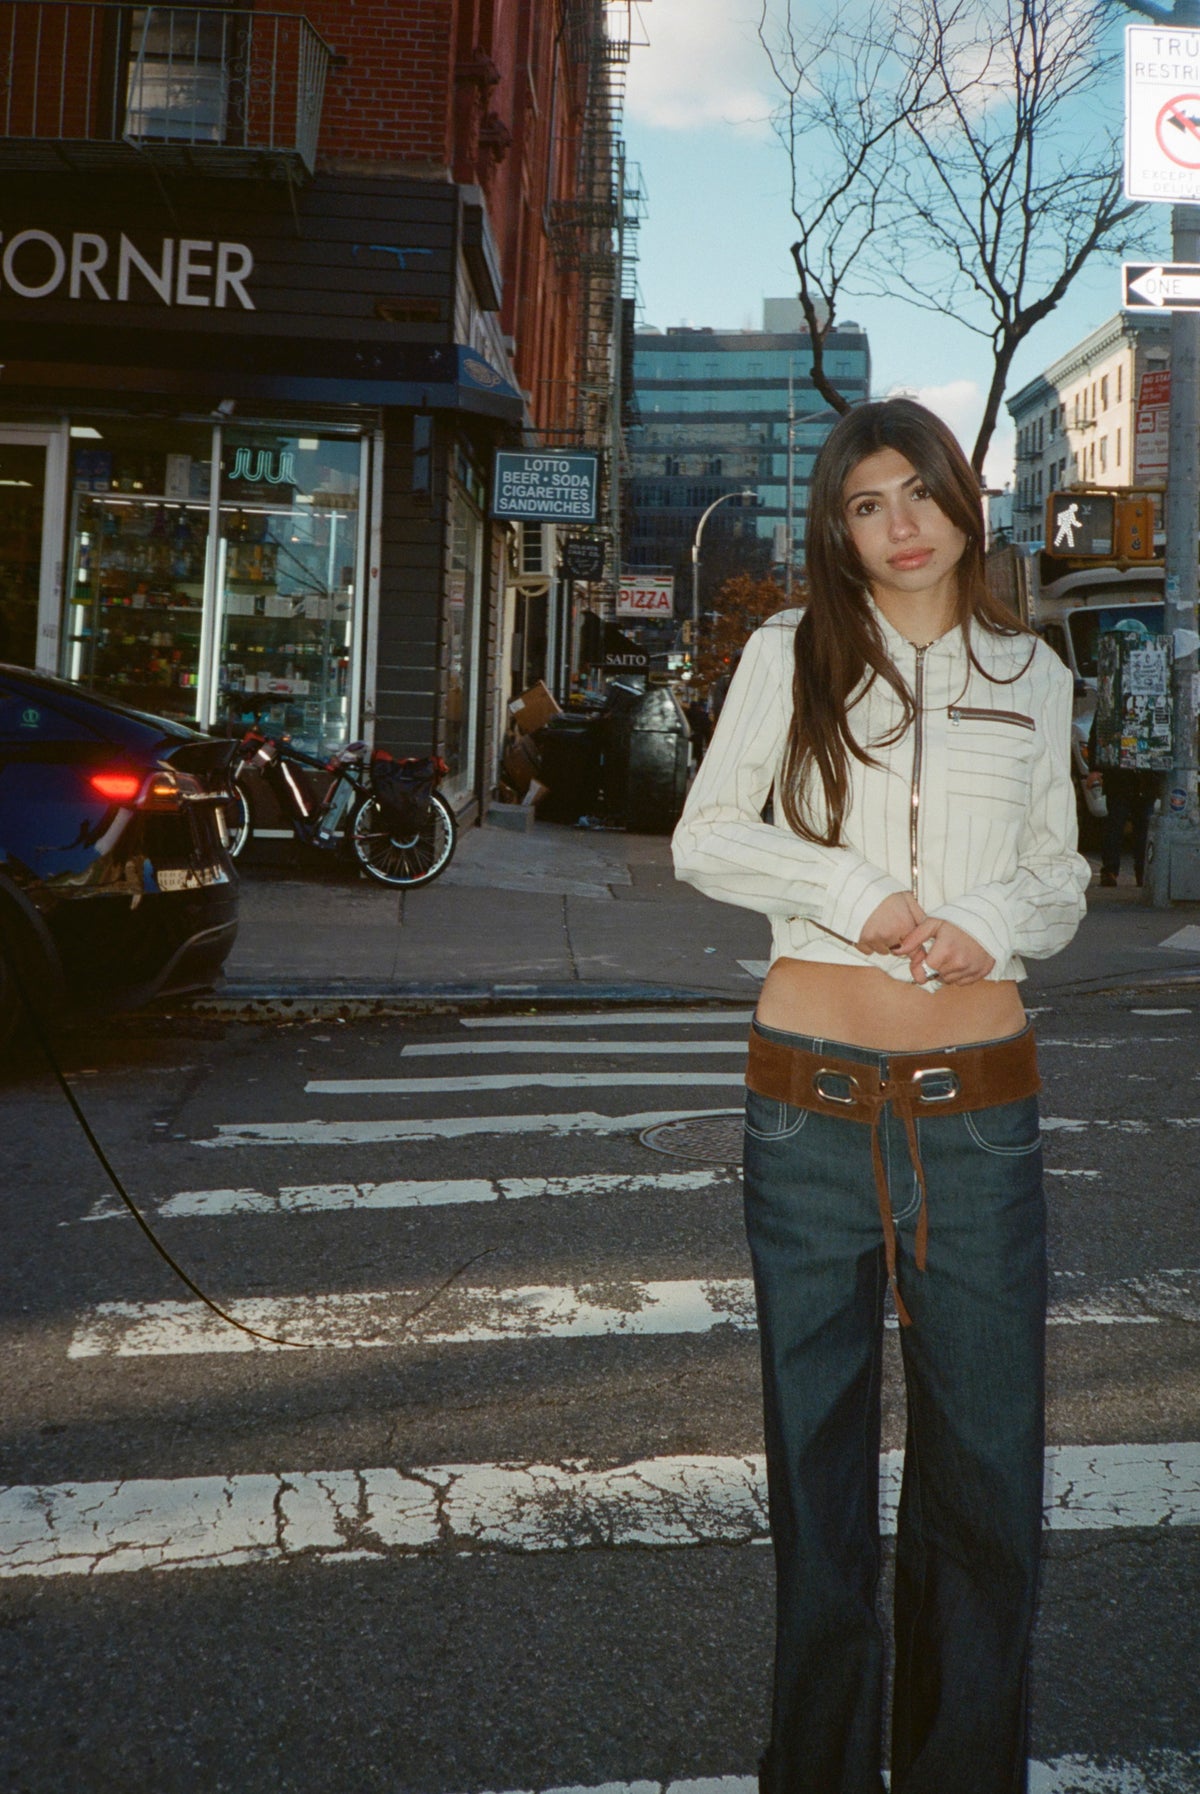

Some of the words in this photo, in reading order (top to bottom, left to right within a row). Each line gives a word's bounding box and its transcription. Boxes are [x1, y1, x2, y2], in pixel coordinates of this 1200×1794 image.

[1142, 169, 1193, 182] EXCEPT
[0, 229, 256, 310] ORNER
[1146, 278, 1184, 295] ONE
[228, 447, 297, 485] JUUL
[524, 459, 570, 473] LOTTO
[502, 471, 540, 485] BEER
[551, 474, 591, 488] SODA
[502, 485, 589, 501] CIGARETTES
[499, 498, 591, 514] SANDWICHES
[617, 590, 670, 609] PIZZA
[605, 653, 647, 666] SAITO
